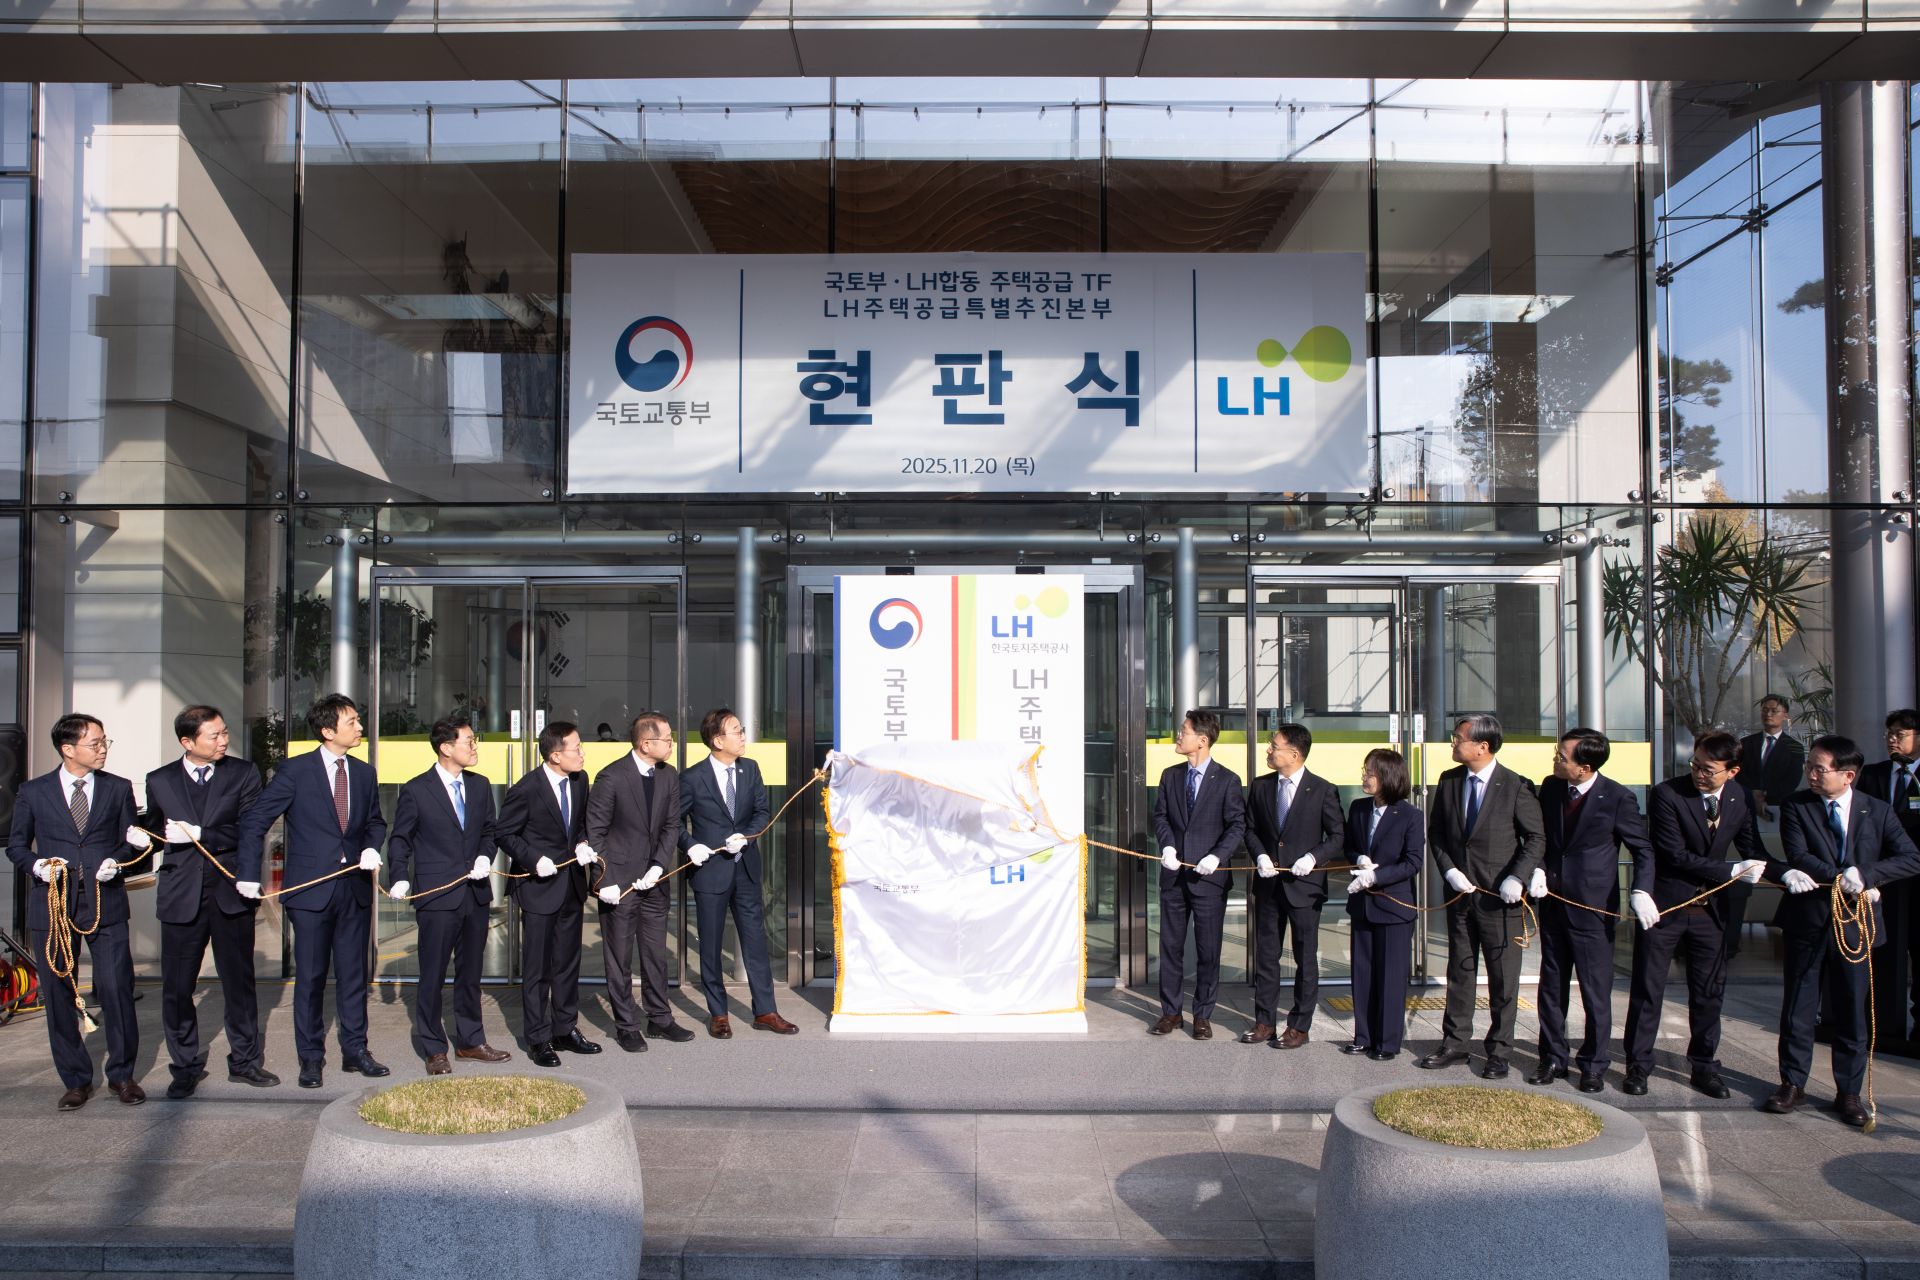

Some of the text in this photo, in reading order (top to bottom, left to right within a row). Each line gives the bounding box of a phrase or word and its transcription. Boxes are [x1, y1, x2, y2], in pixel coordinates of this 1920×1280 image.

[990, 271, 1075, 294] 주택공급
[1081, 274, 1113, 292] TF
[824, 297, 1114, 321] LH주택공급특별추진본부
[1217, 377, 1290, 416] LH
[596, 401, 712, 427] 국토교통부
[901, 456, 1036, 478] 2025.11.20 (목)
[991, 615, 1033, 638] LH
[991, 642, 1070, 654] 한국토지주택공사
[883, 668, 908, 742] 국토부
[990, 864, 1025, 885] LH
